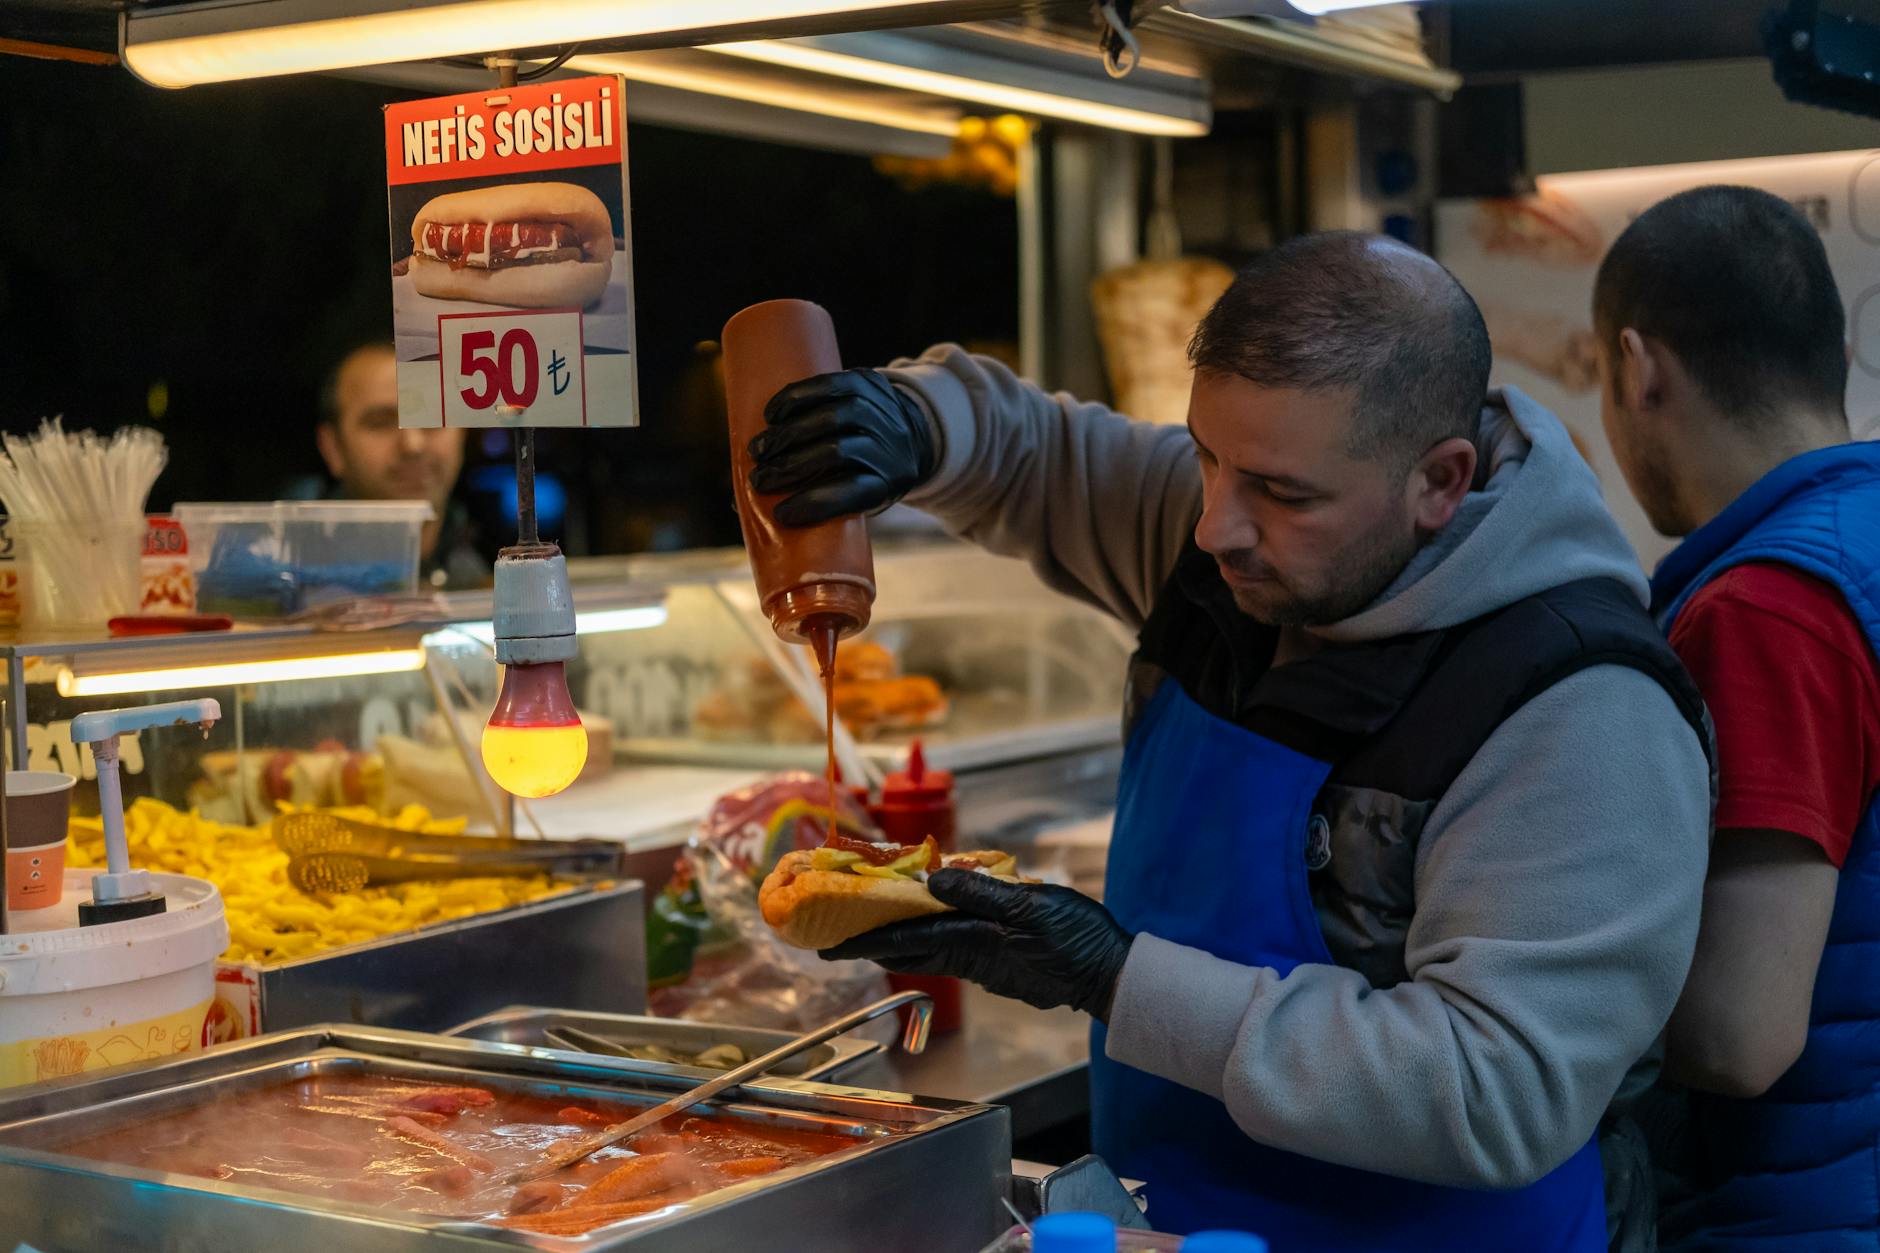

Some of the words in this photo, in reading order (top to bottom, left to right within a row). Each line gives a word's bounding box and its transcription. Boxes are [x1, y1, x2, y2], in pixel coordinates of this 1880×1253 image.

[402, 105, 486, 167] NEFİS
[494, 87, 613, 158] SOSİSLİ
[460, 328, 539, 411] 50
